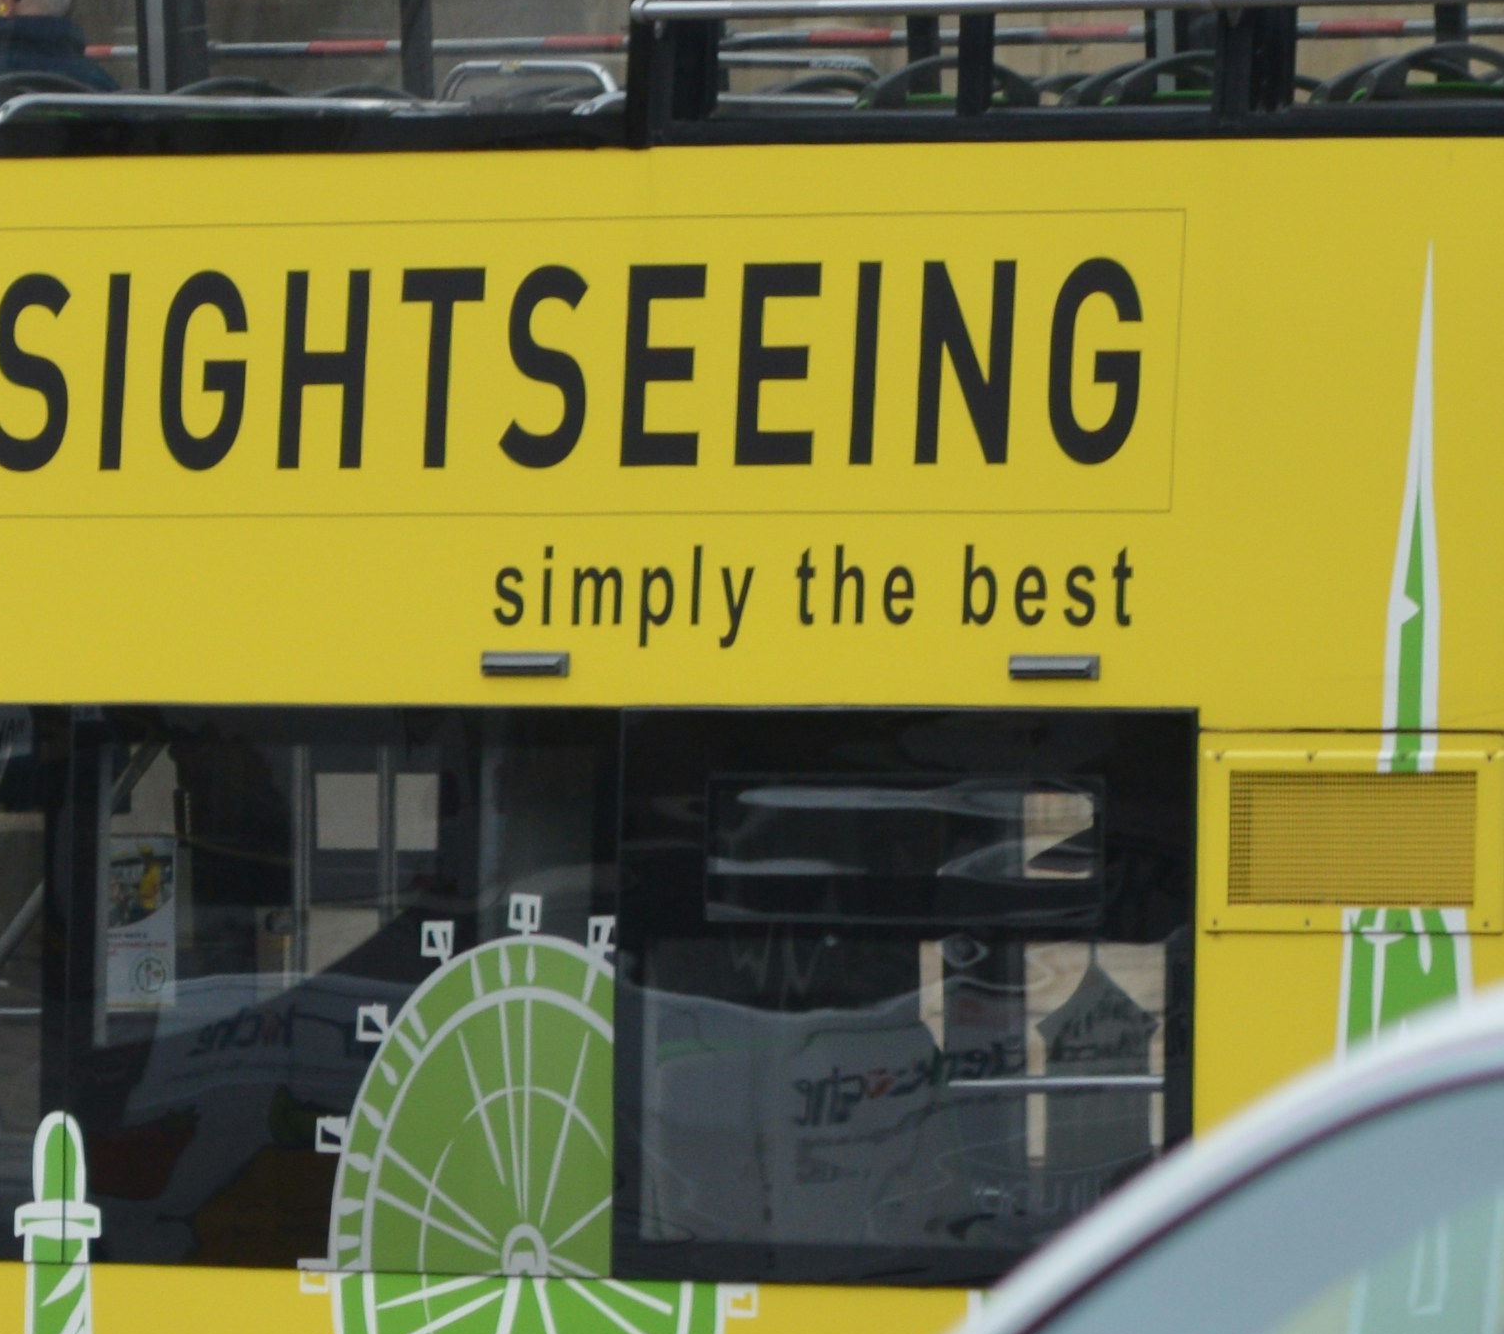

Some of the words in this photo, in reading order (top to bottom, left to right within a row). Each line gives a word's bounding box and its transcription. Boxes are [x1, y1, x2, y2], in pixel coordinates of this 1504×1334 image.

[493, 544, 755, 648] simply
[794, 543, 916, 626] the
[960, 543, 1135, 627] best
